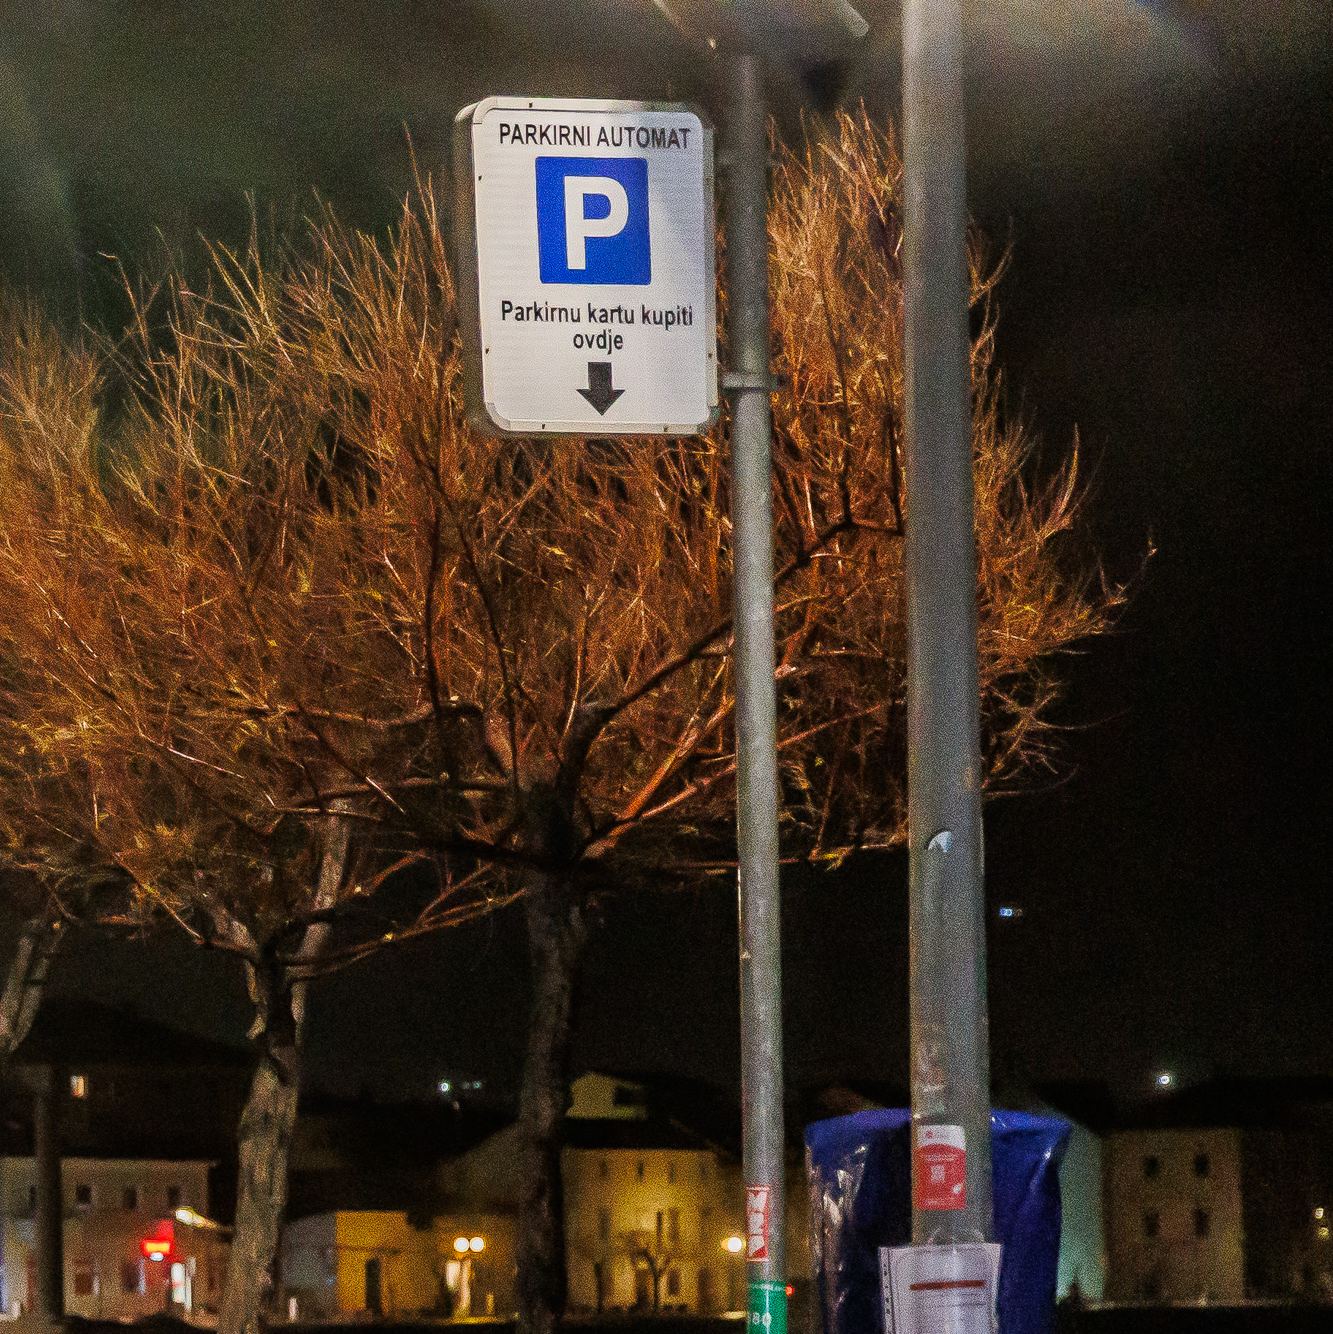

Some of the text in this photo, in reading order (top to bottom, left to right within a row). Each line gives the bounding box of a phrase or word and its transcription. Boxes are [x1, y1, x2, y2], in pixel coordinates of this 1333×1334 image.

[499, 123, 691, 150] PARKIRNI AUTOMAT
[564, 175, 629, 270] P
[501, 300, 693, 331] Parkirnu kartu kupiti
[572, 328, 624, 355] ovdje
